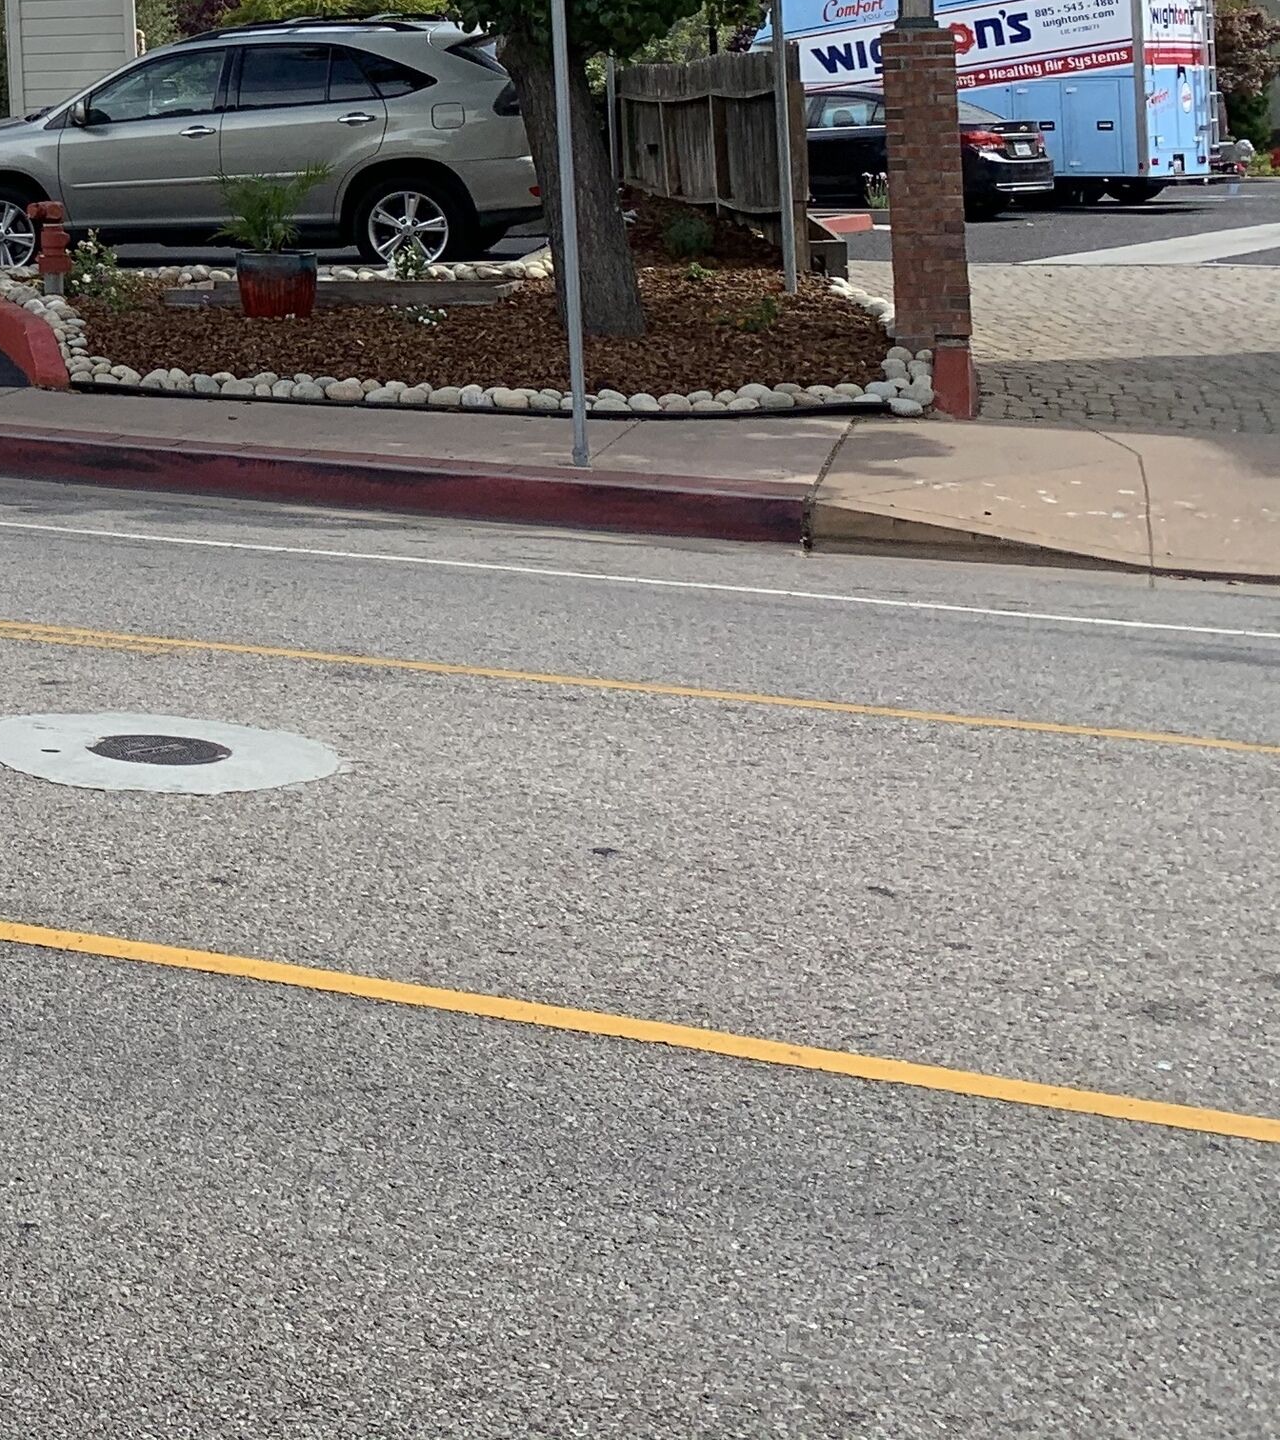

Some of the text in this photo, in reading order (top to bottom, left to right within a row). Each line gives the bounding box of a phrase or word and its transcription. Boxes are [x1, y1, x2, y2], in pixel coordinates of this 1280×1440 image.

[1042, 9, 1115, 28] wightons.com
[989, 63, 1042, 80] Healthy
[1045, 59, 1065, 72] Air
[1068, 49, 1129, 70] Systems
